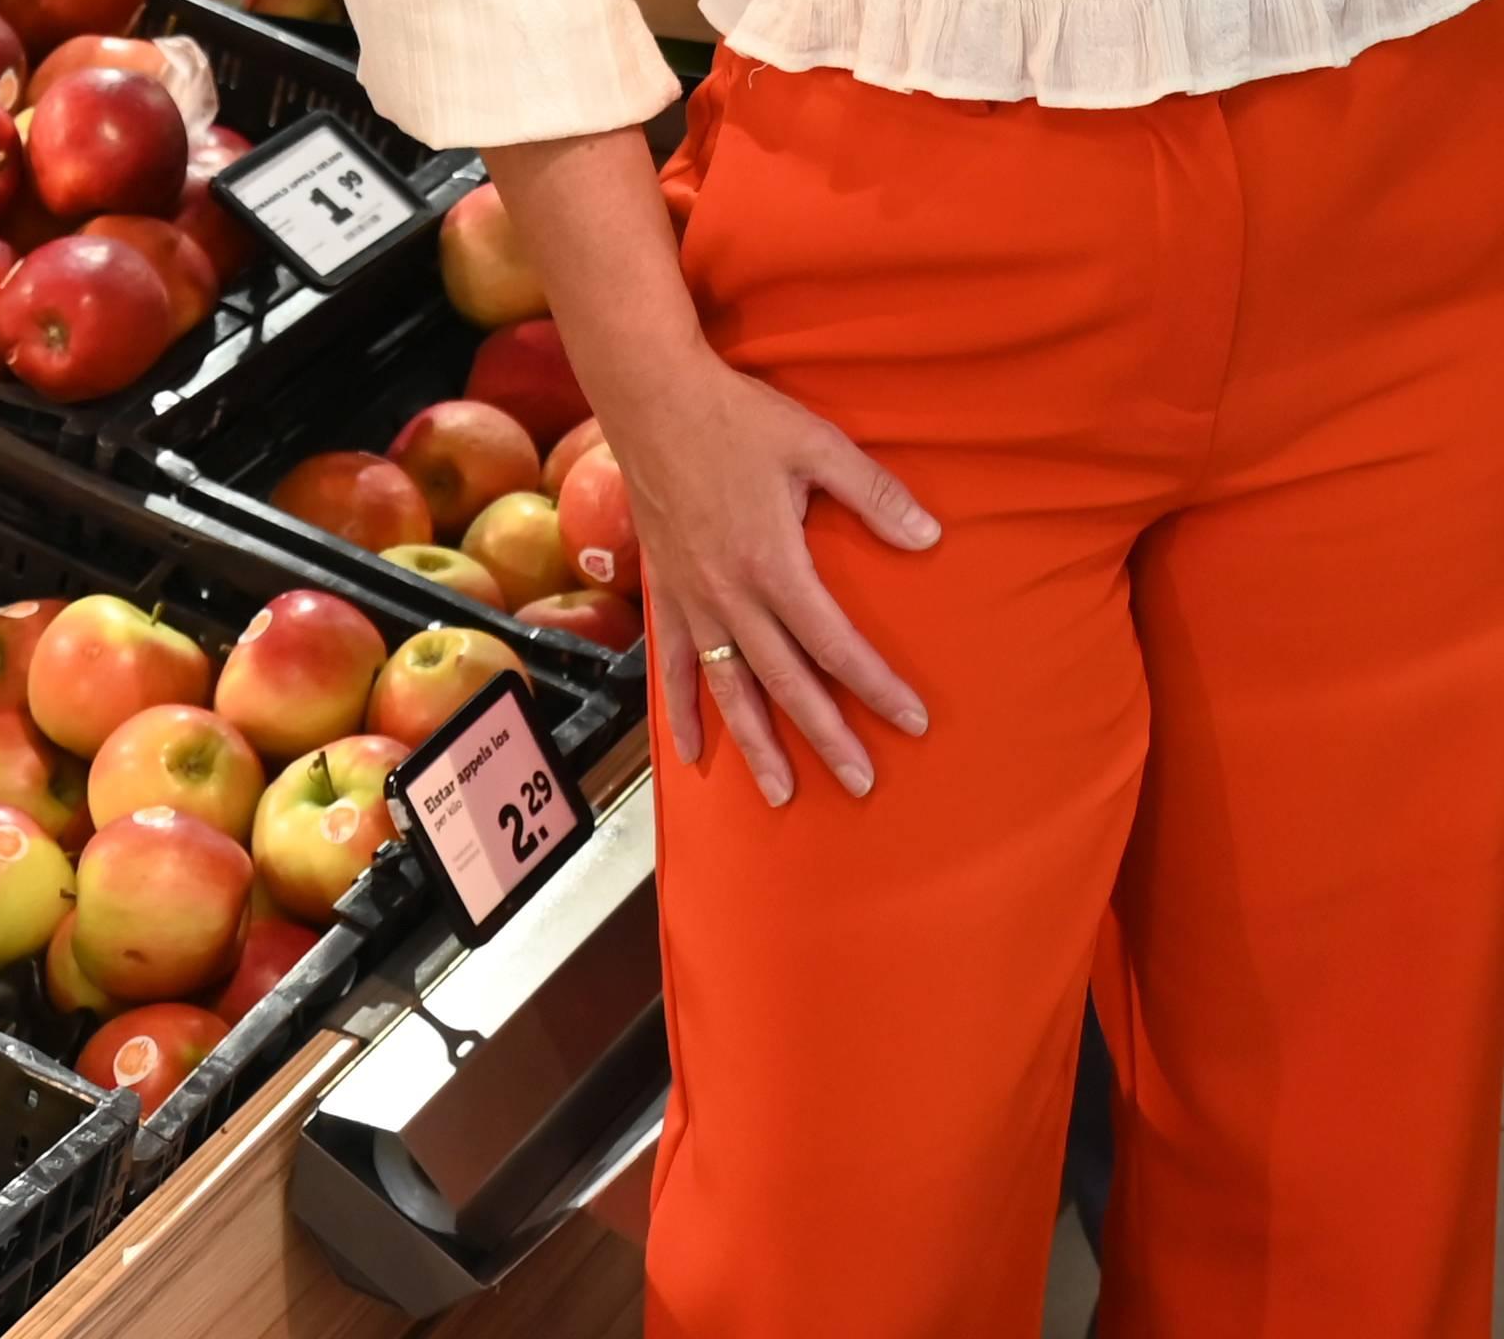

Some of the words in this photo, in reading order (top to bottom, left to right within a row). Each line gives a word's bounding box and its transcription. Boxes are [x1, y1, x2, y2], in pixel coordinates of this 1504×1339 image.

[423, 779, 456, 815] Elstar
[456, 746, 494, 785] appels
[490, 728, 510, 751] los
[434, 814, 448, 834] per
[446, 799, 463, 818] kilo
